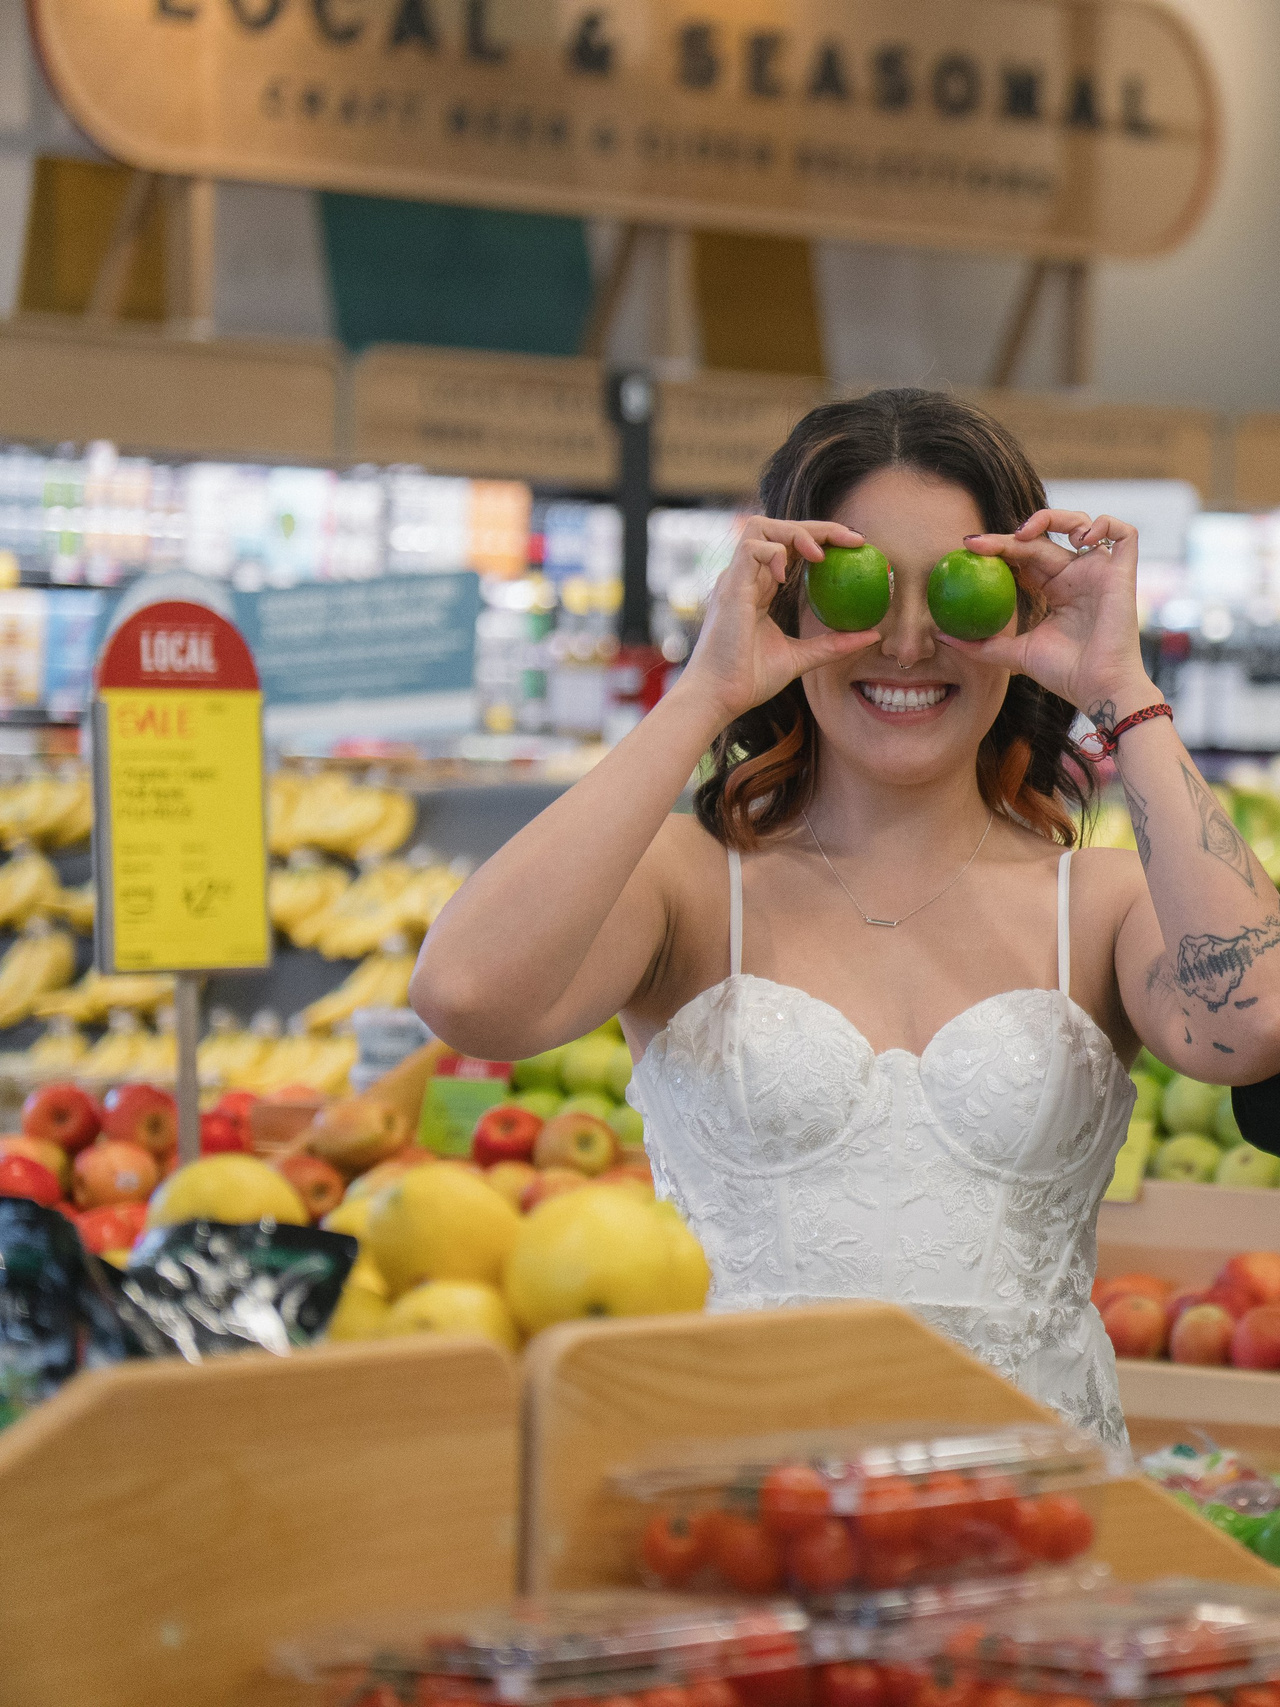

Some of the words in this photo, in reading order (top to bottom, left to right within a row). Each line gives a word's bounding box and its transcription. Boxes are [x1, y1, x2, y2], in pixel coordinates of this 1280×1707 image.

[154, 0, 510, 64] CAL
[572, 12, 614, 78] &
[676, 18, 1164, 141] SEASONAL
[141, 630, 218, 674] LOCAL
[116, 701, 200, 740] SALE
